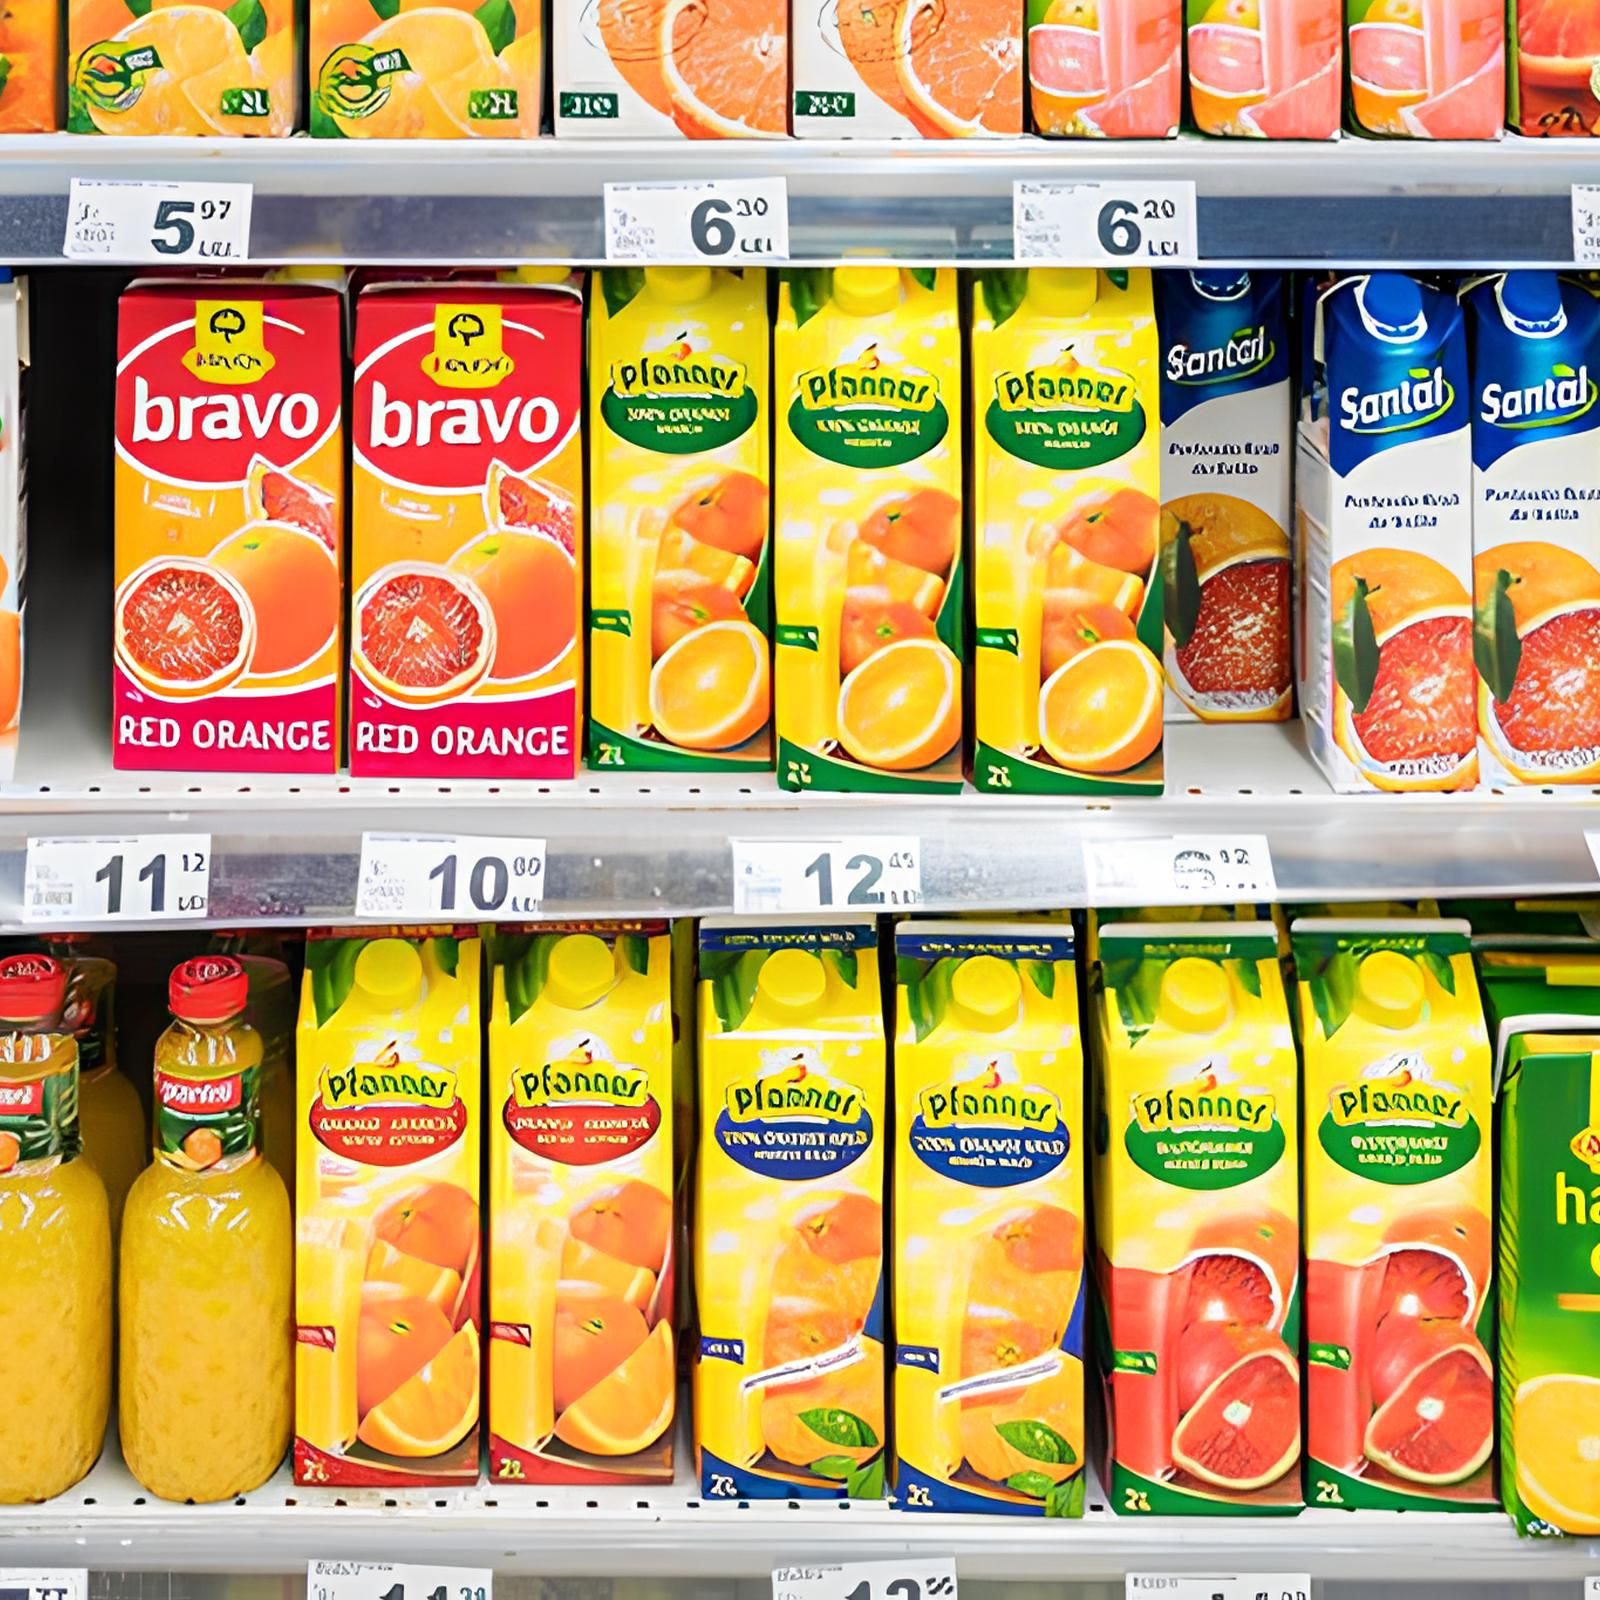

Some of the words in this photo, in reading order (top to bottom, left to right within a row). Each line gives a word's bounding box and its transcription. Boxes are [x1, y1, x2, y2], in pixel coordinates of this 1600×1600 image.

[151, 202, 194, 255] 5
[690, 199, 735, 255] 6
[1098, 200, 1142, 256] 6
[133, 377, 320, 442] bravo
[372, 382, 560, 447] bravo
[118, 717, 182, 748] RED
[193, 717, 331, 750] ORANGE
[357, 721, 420, 752] RED
[431, 725, 569, 756] ORANGE
[183, 854, 205, 873] 12
[430, 854, 508, 911] 10
